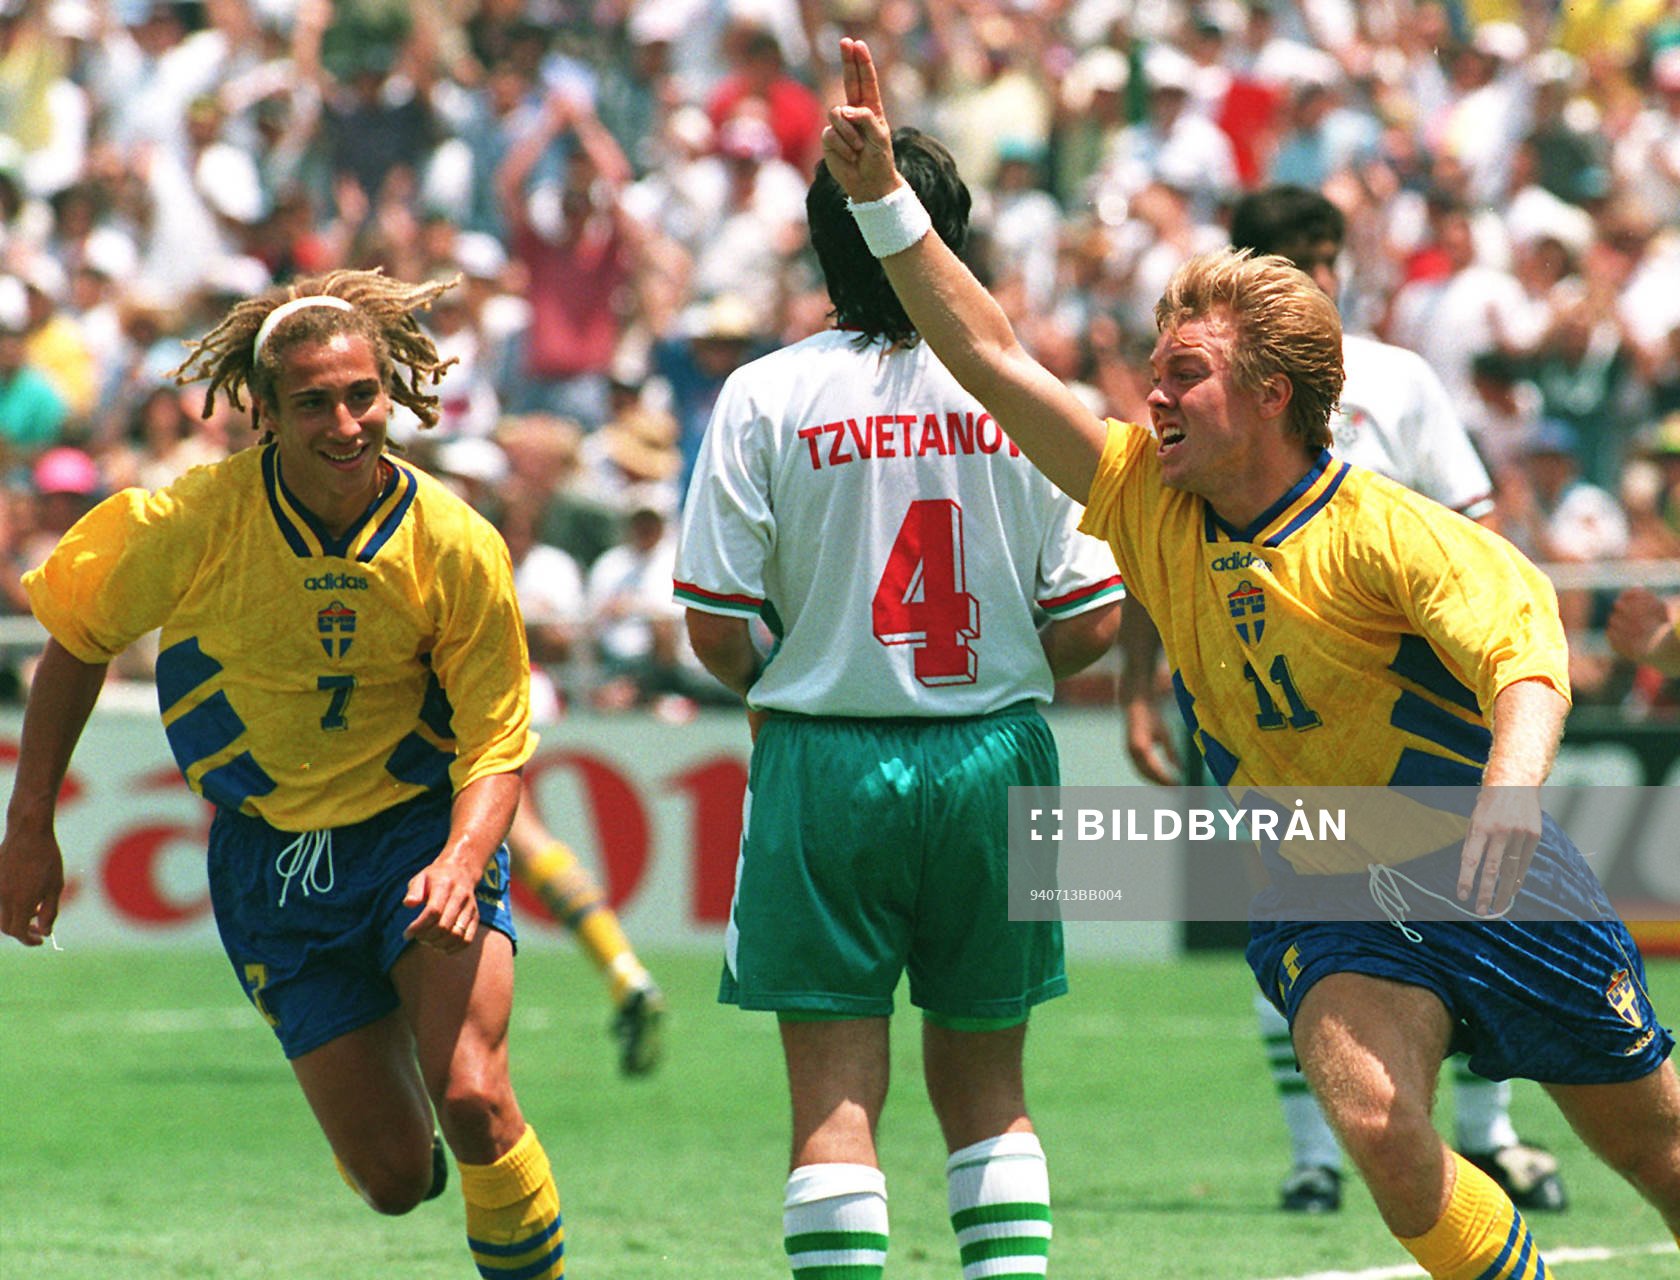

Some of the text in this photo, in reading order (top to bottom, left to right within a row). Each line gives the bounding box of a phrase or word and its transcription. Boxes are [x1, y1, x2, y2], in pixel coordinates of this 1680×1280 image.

[798, 412, 1020, 470] TZVETANO
[303, 573, 369, 591] adidas
[872, 499, 980, 688] 4
[317, 674, 357, 731] 7
[1243, 654, 1323, 732] 11
